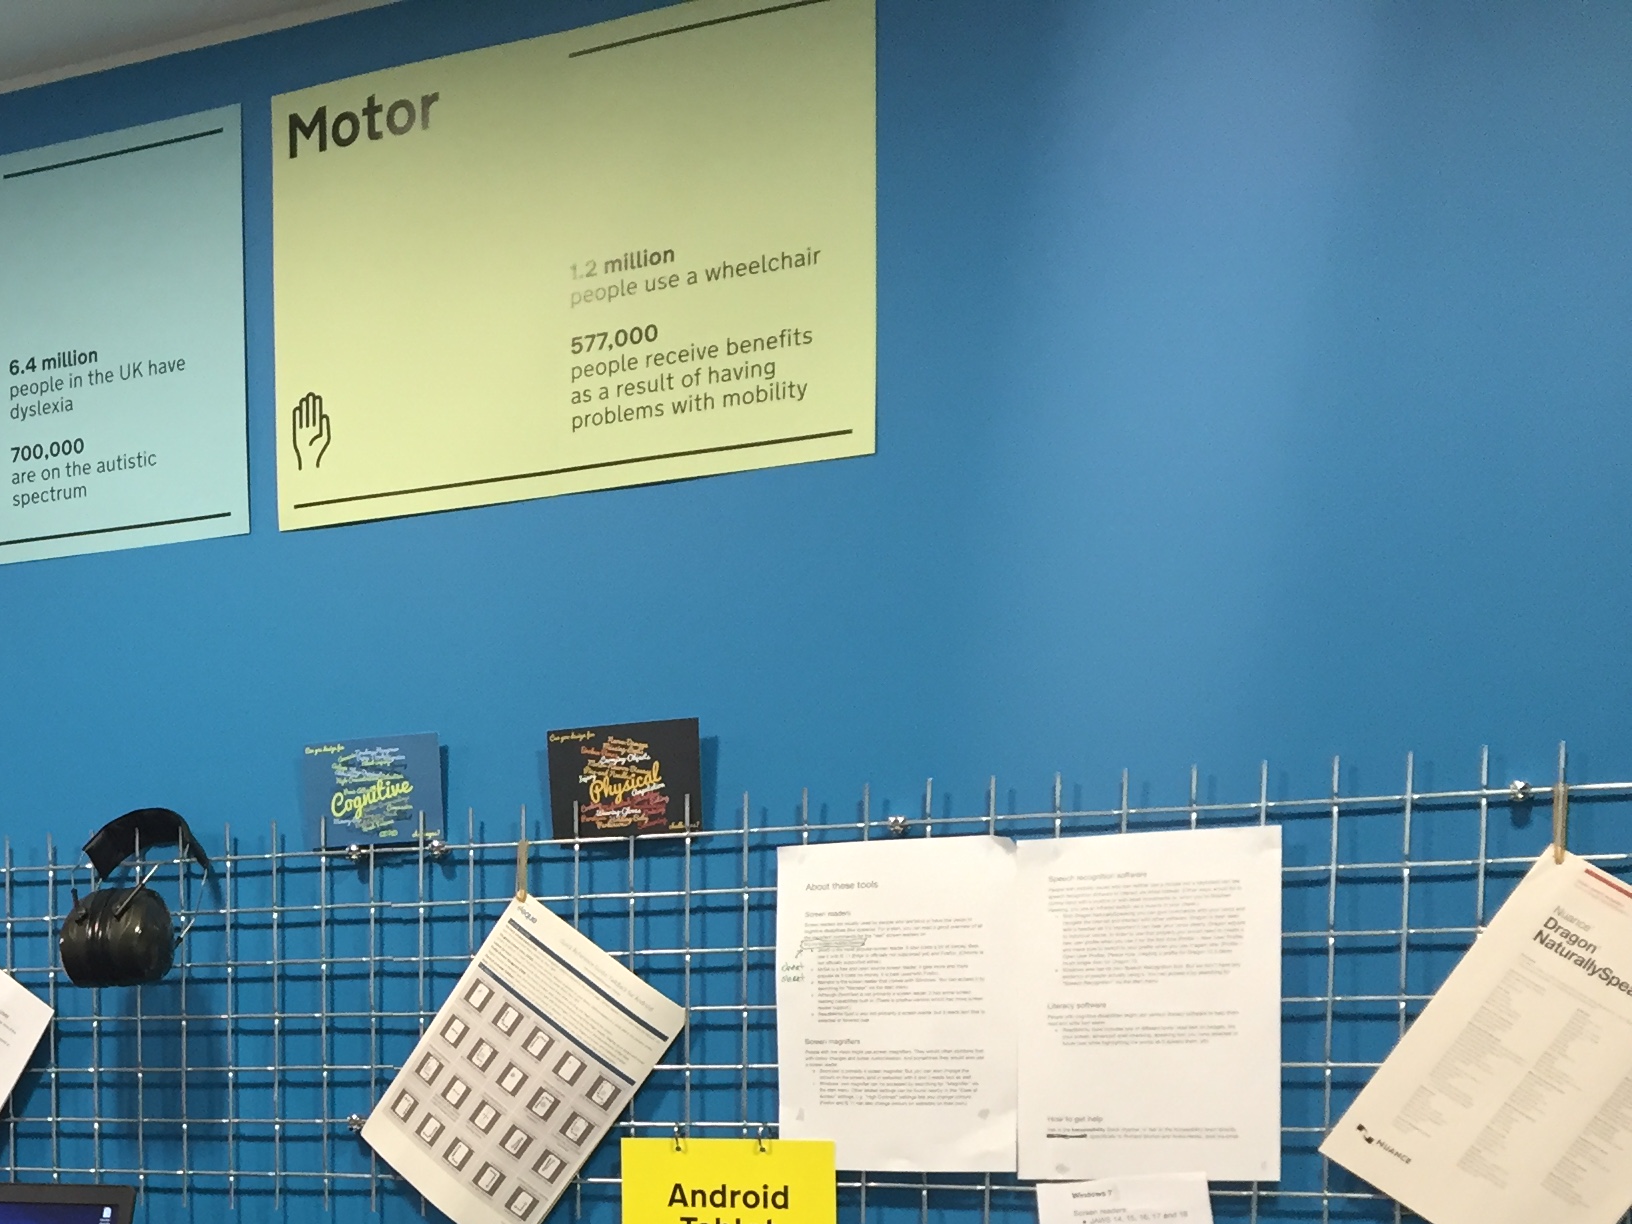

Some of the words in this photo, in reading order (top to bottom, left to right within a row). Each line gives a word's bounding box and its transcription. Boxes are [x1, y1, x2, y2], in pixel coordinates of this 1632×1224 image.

[288, 91, 440, 159] Motor
[569, 260, 598, 280] 1.2
[604, 249, 675, 274] million
[570, 279, 637, 308] people
[645, 273, 679, 292] use
[686, 270, 698, 285] a
[705, 247, 821, 282] wheelchair
[571, 324, 658, 354] 577,000
[571, 354, 638, 383] people
[646, 343, 719, 368] receive
[727, 328, 813, 356] benefits
[9, 357, 36, 375] 6.4
[42, 350, 98, 370] million
[10, 376, 64, 400] people
[69, 373, 83, 388] in
[88, 369, 114, 386] the
[119, 362, 143, 380] UK
[148, 358, 185, 376] have
[571, 389, 591, 404] as
[598, 386, 609, 401] a
[617, 372, 674, 398] result
[681, 368, 702, 388] of
[708, 360, 776, 384] having
[10, 397, 73, 421] dyslexia
[572, 402, 665, 432] problems
[672, 393, 715, 415] with
[723, 381, 808, 407] mobility
[11, 438, 84, 463] 700,000
[12, 470, 36, 484] are
[41, 467, 60, 481] on
[65, 462, 91, 478] the
[96, 451, 157, 473] autistic
[13, 485, 87, 508] spectrum
[331, 779, 413, 819] Cognitive
[589, 761, 662, 804] Physical
[806, 883, 830, 891] About
[857, 880, 878, 889] tools
[1543, 916, 1597, 954] Dragon
[667, 1183, 790, 1210] Android
